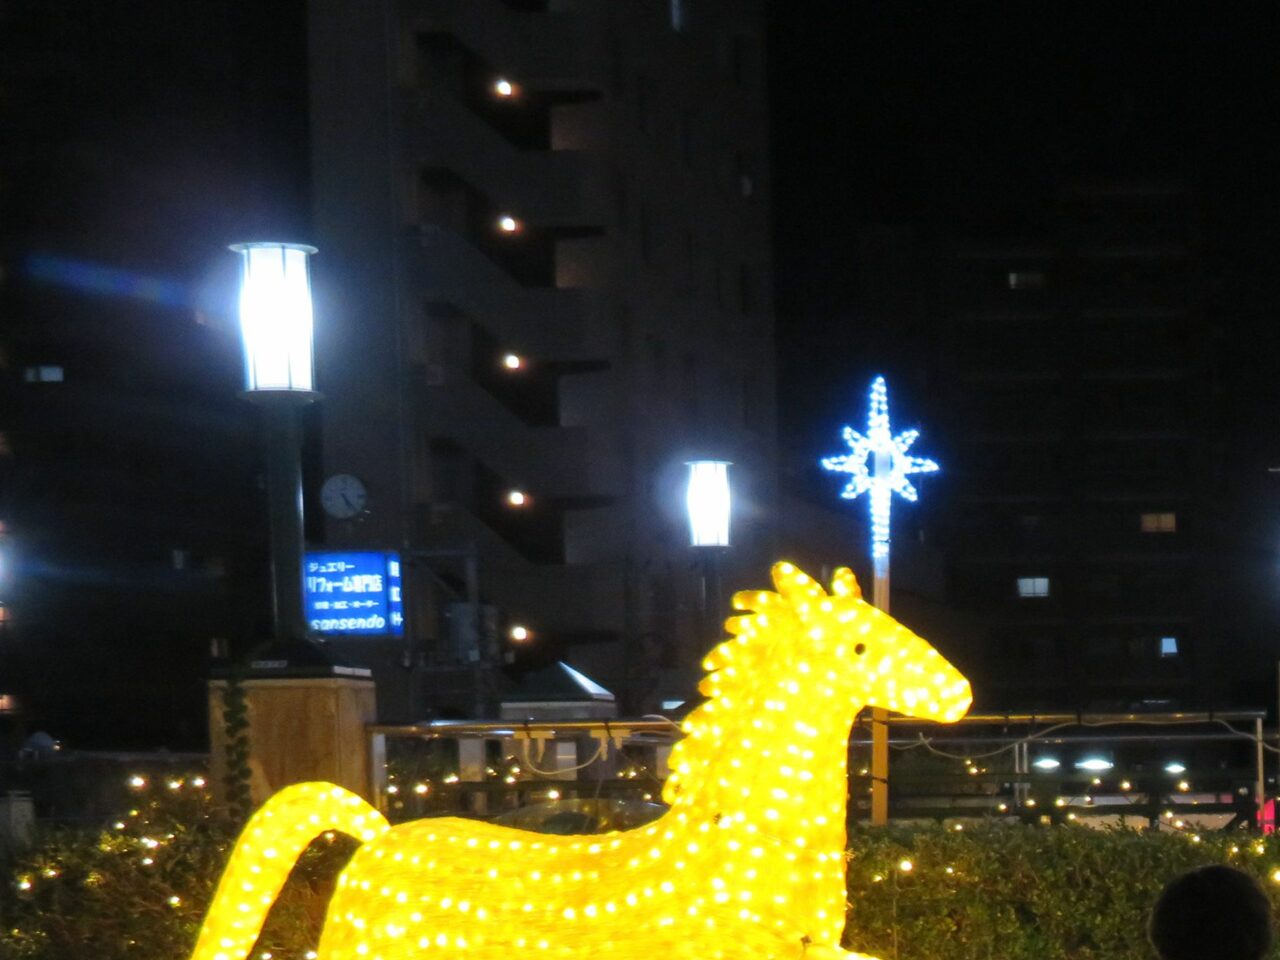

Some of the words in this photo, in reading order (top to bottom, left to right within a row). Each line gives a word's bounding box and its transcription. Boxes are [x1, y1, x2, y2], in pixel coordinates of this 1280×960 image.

[307, 574, 383, 593] リフォーム専門店
[311, 614, 386, 631] sansendo
